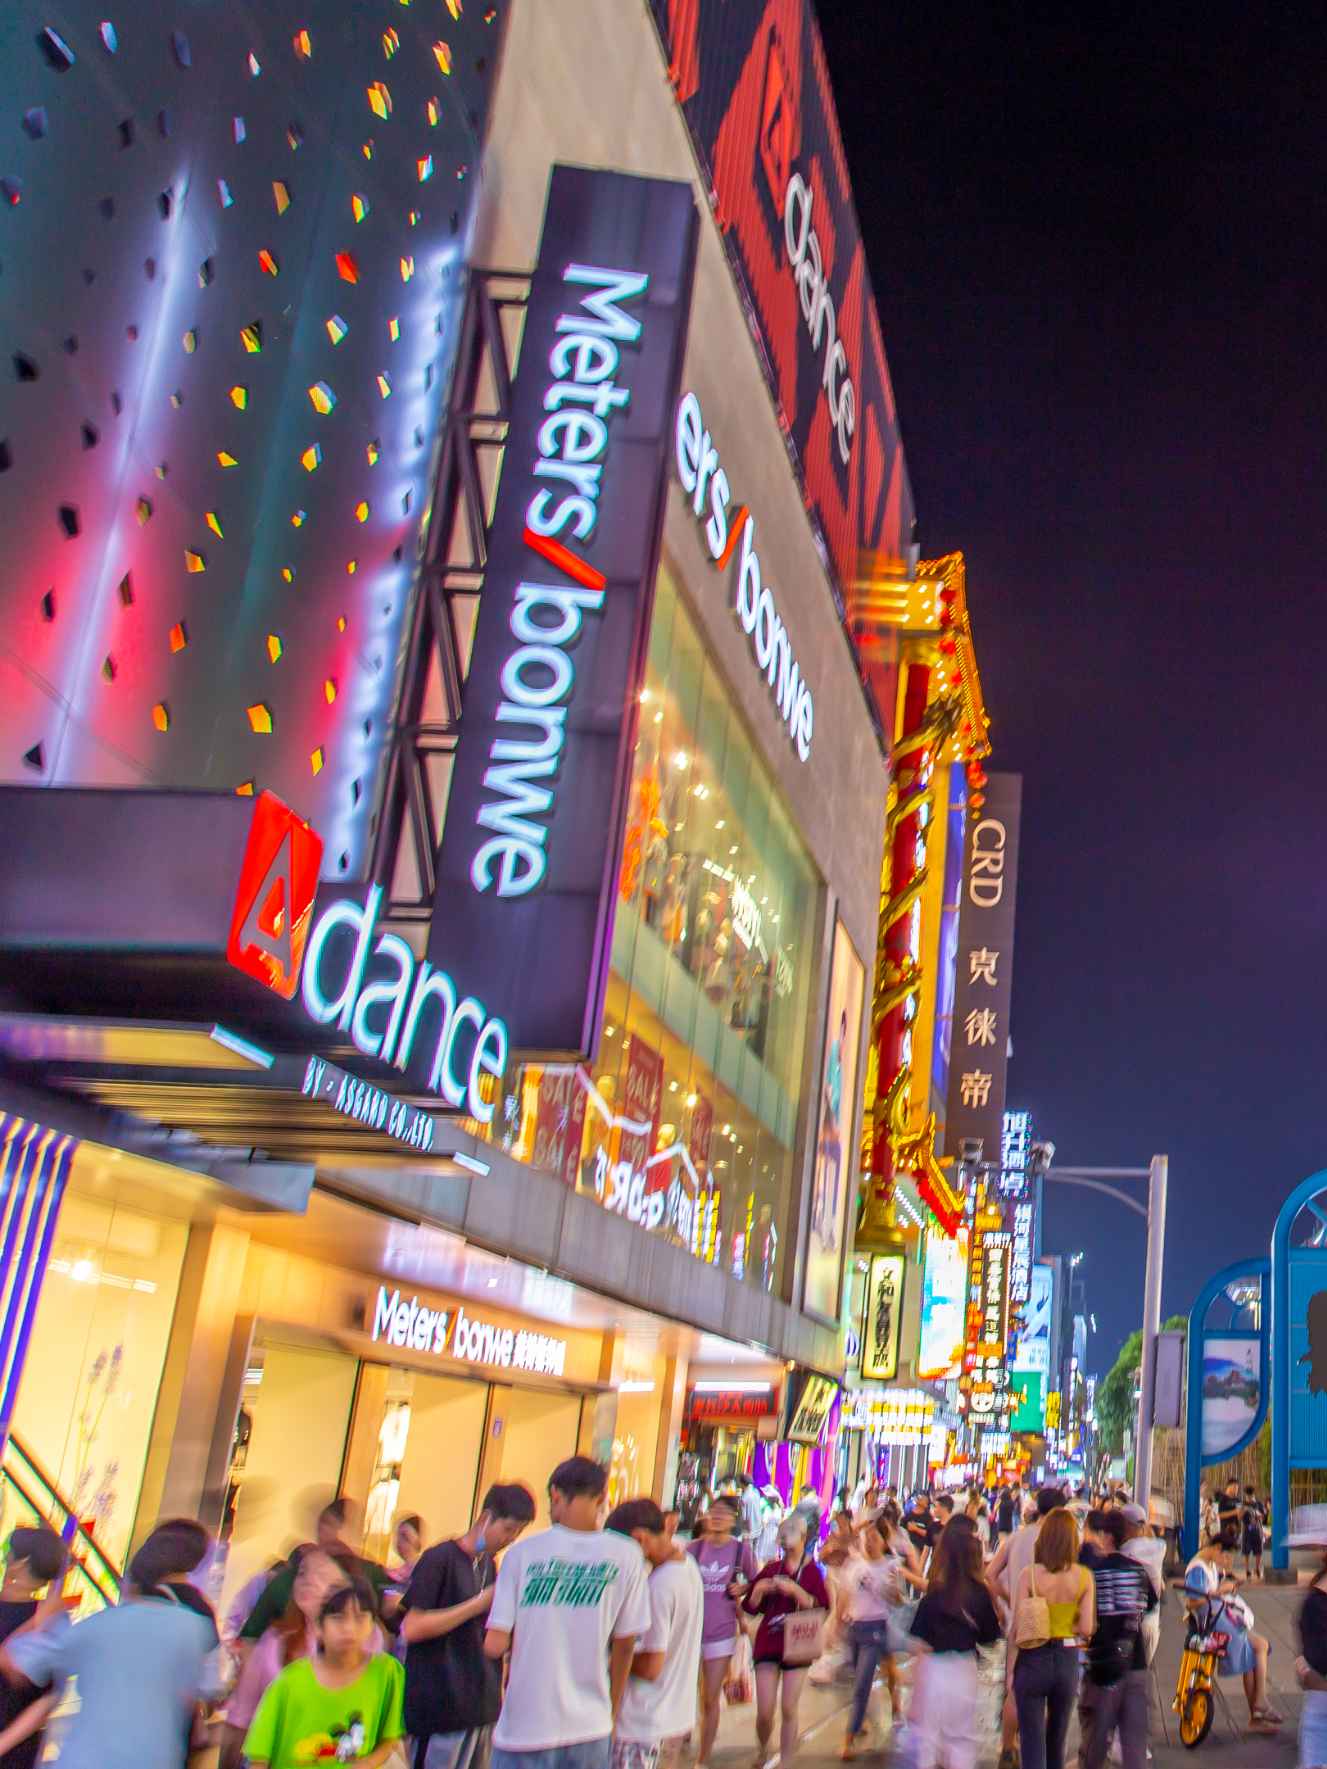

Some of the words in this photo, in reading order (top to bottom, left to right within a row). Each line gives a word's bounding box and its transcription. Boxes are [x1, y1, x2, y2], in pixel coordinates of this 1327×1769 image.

[471, 262, 649, 897] Meters/bonwe
[969, 817, 1006, 908] CRD
[302, 880, 509, 1123] dance
[960, 946, 1000, 1110] 克徕帝
